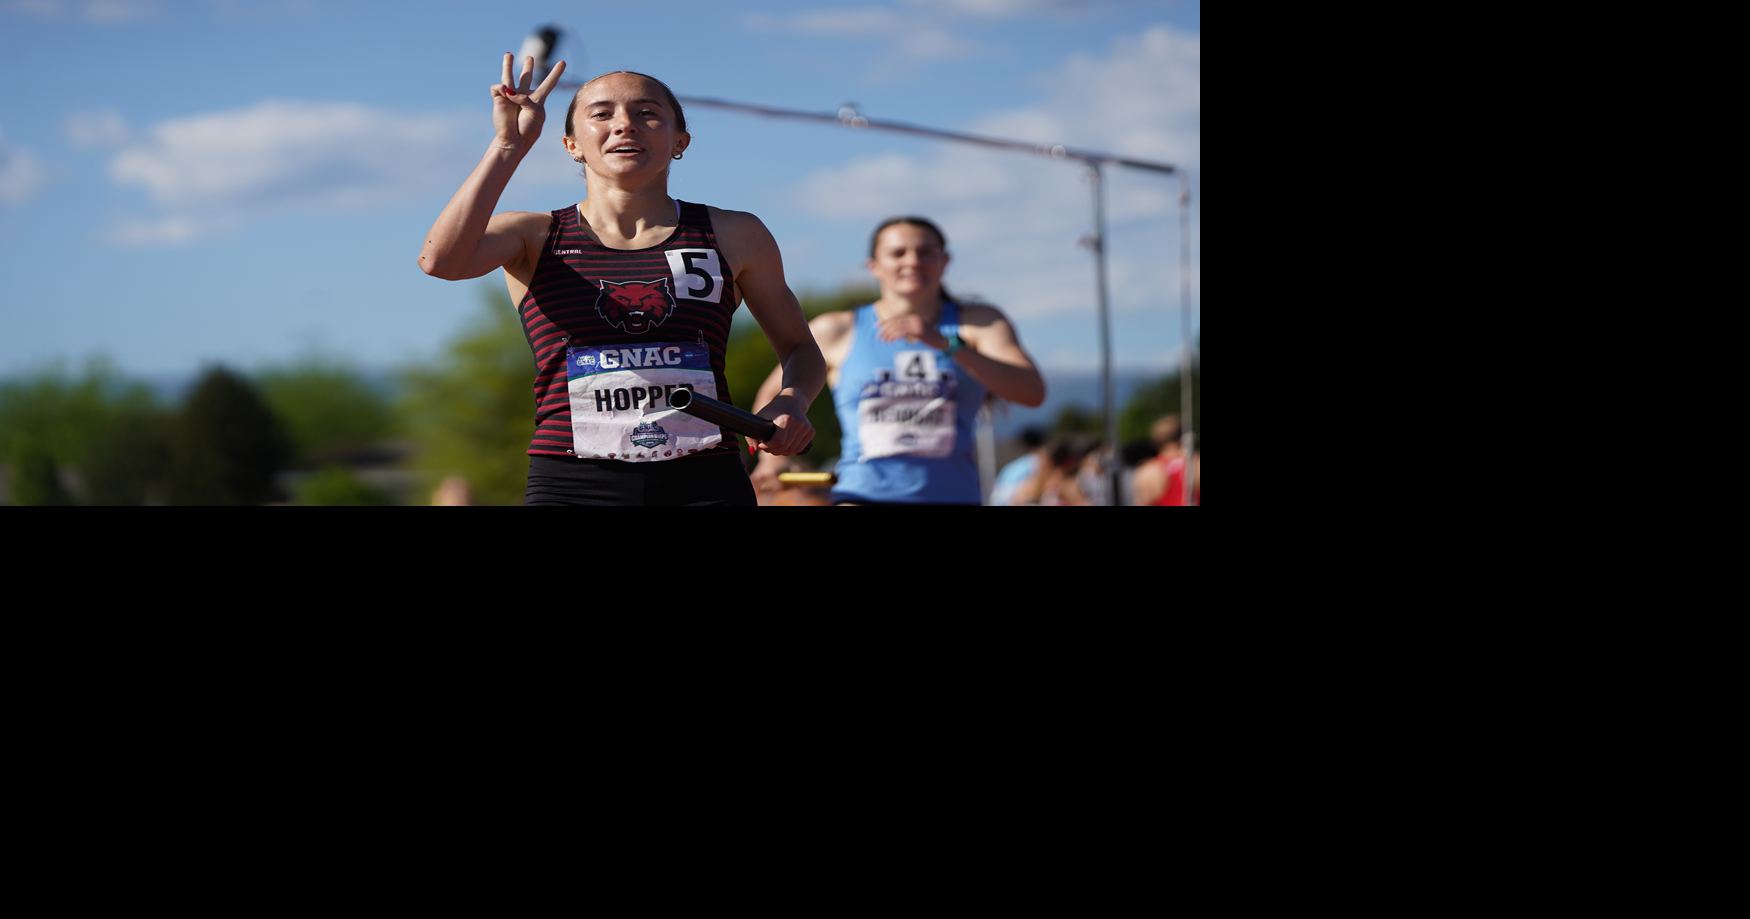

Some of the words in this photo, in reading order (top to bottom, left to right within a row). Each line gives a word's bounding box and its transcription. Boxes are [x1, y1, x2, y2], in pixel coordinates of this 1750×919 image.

[680, 252, 715, 299] 5
[600, 346, 681, 369] GNAC
[905, 355, 926, 379] 4
